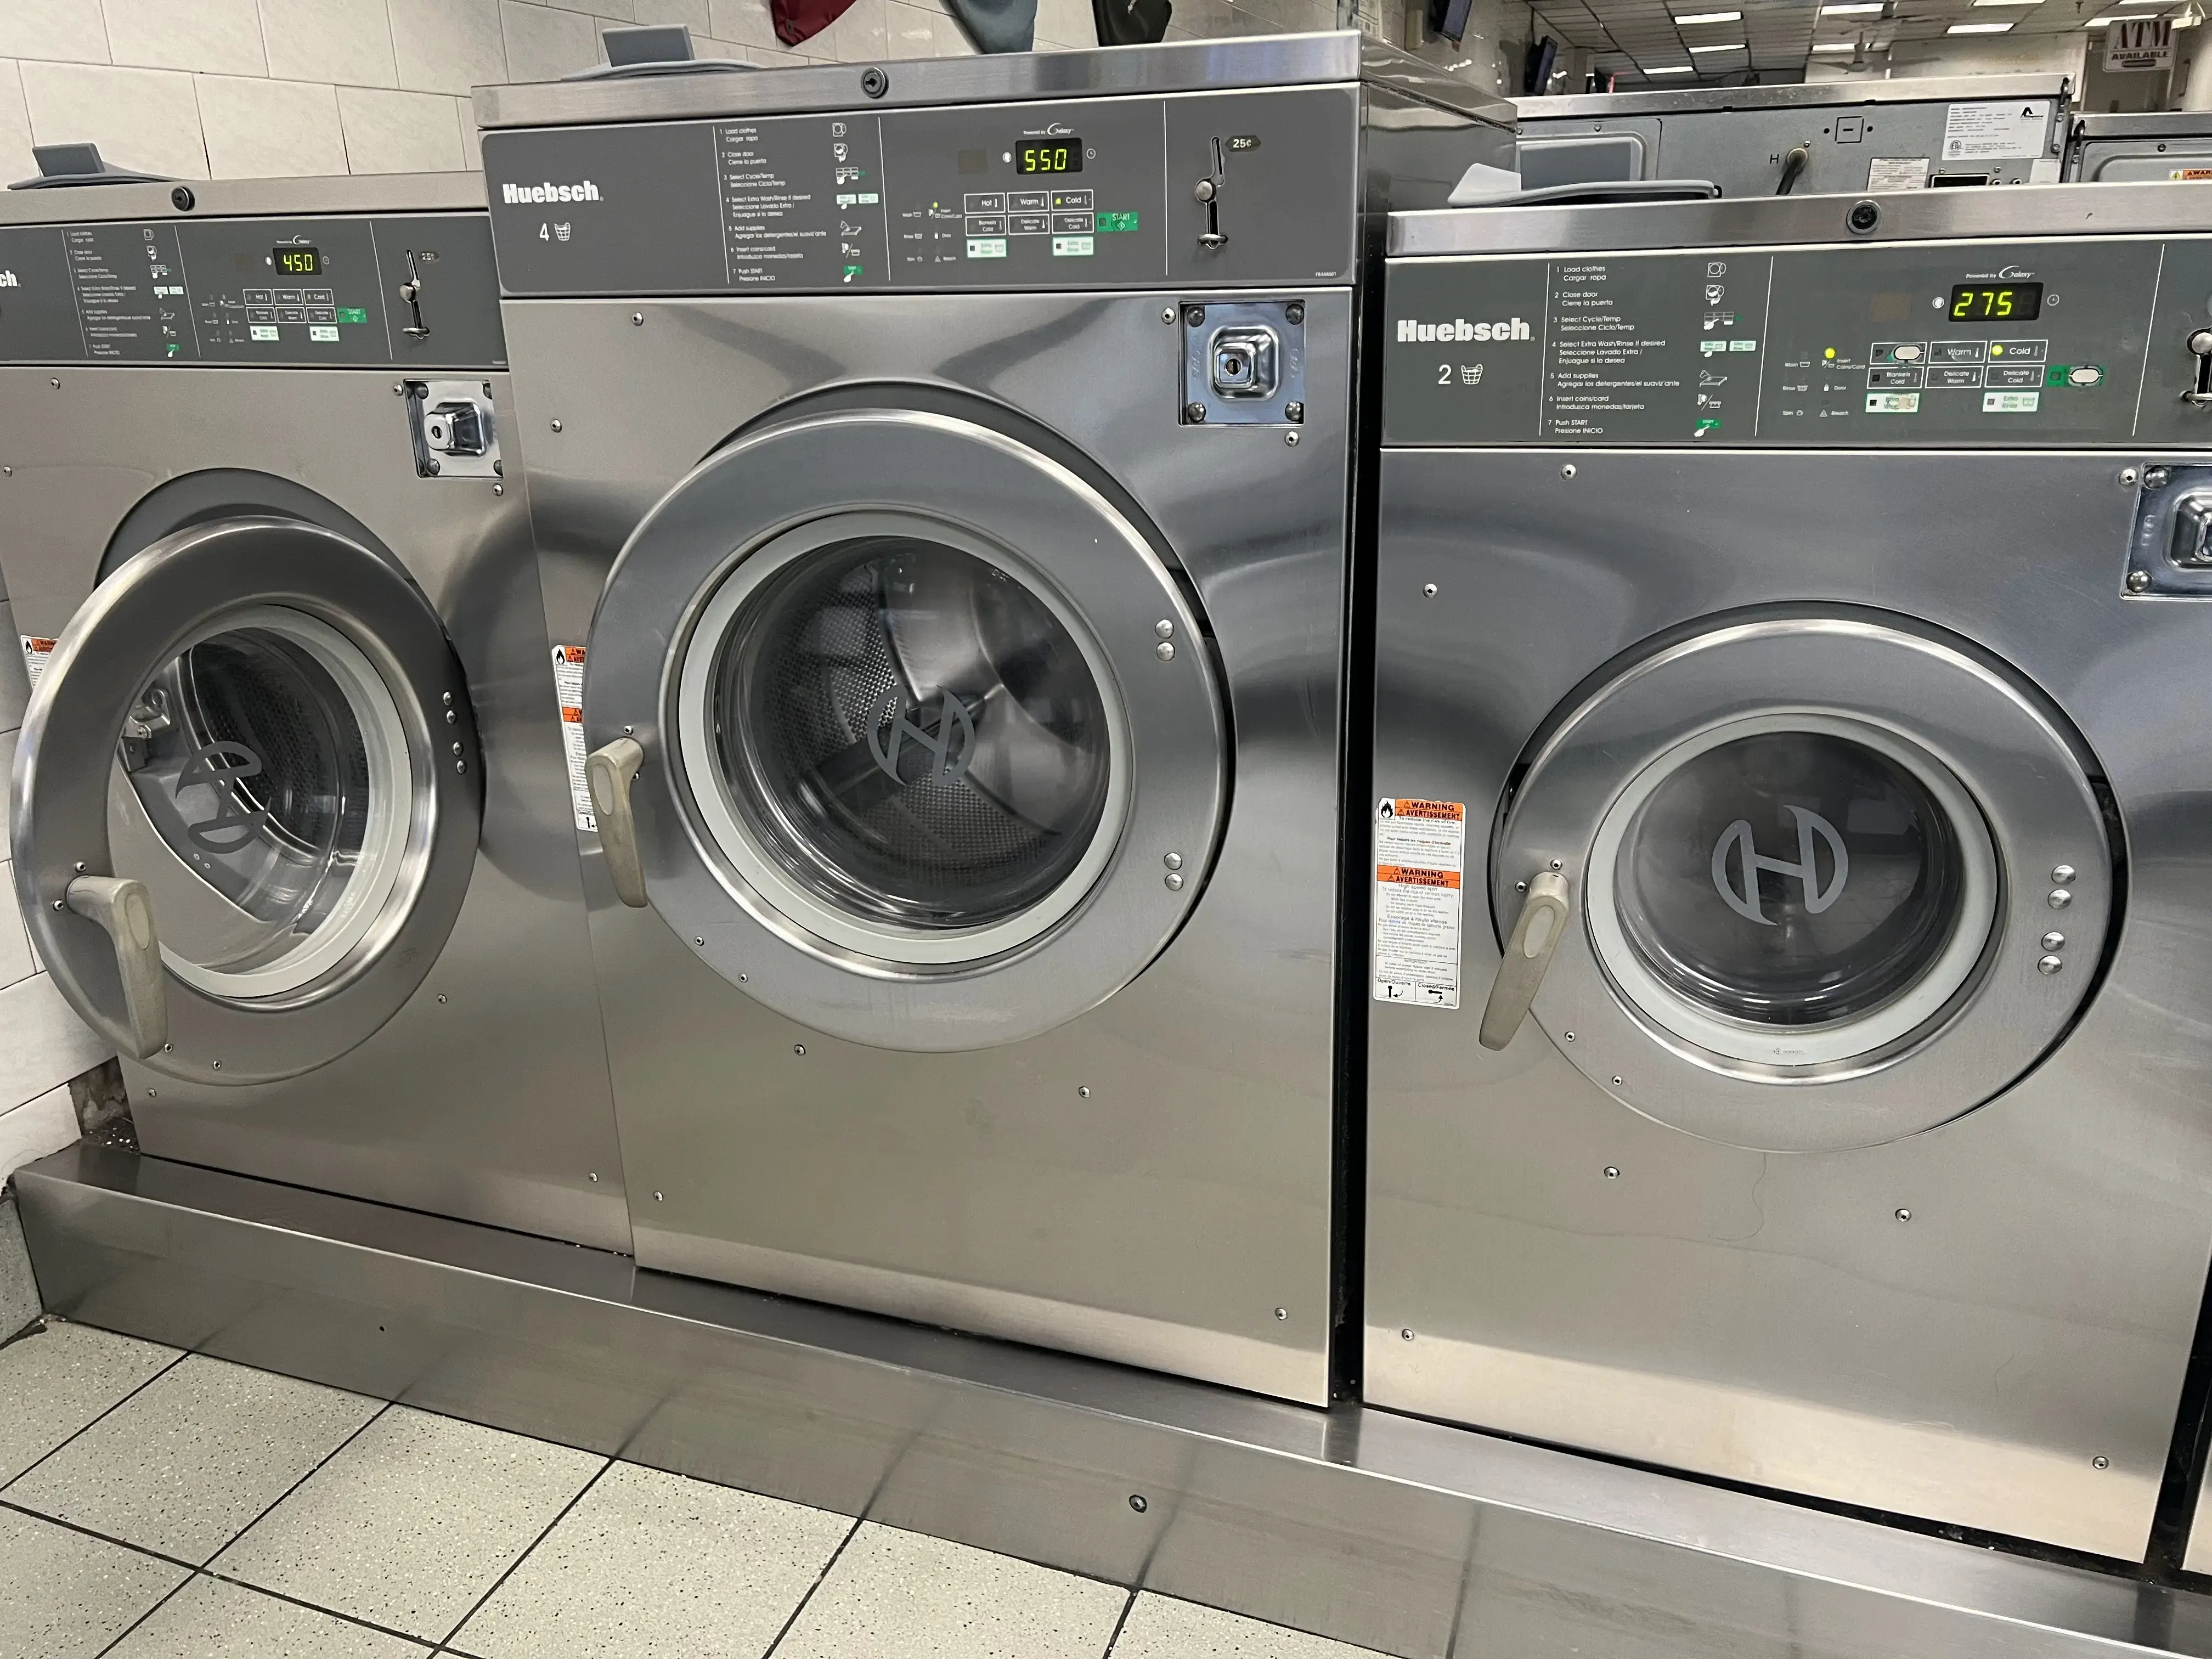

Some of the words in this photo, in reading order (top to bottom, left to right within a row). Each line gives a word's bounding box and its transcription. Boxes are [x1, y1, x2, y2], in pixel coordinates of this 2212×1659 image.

[2114, 20, 2171, 49] ATM
[2112, 52, 2168, 60] AVAILABLE
[1233, 139, 1252, 148] 25¢
[1025, 149, 1066, 171] 550
[1770, 154, 1779, 164] H
[503, 180, 599, 204] Huebsch
[539, 224, 549, 241] 4
[283, 255, 313, 271] 450
[1954, 292, 2012, 316] 275
[1397, 318, 1530, 342] Huebsch
[1438, 364, 1451, 384] 2
[1406, 810, 1460, 819] AVERTISSEMENT
[1412, 802, 1454, 811] WARNING
[1402, 868, 1443, 878] WARNING
[1396, 876, 1449, 887] AVERTISSEMENT
